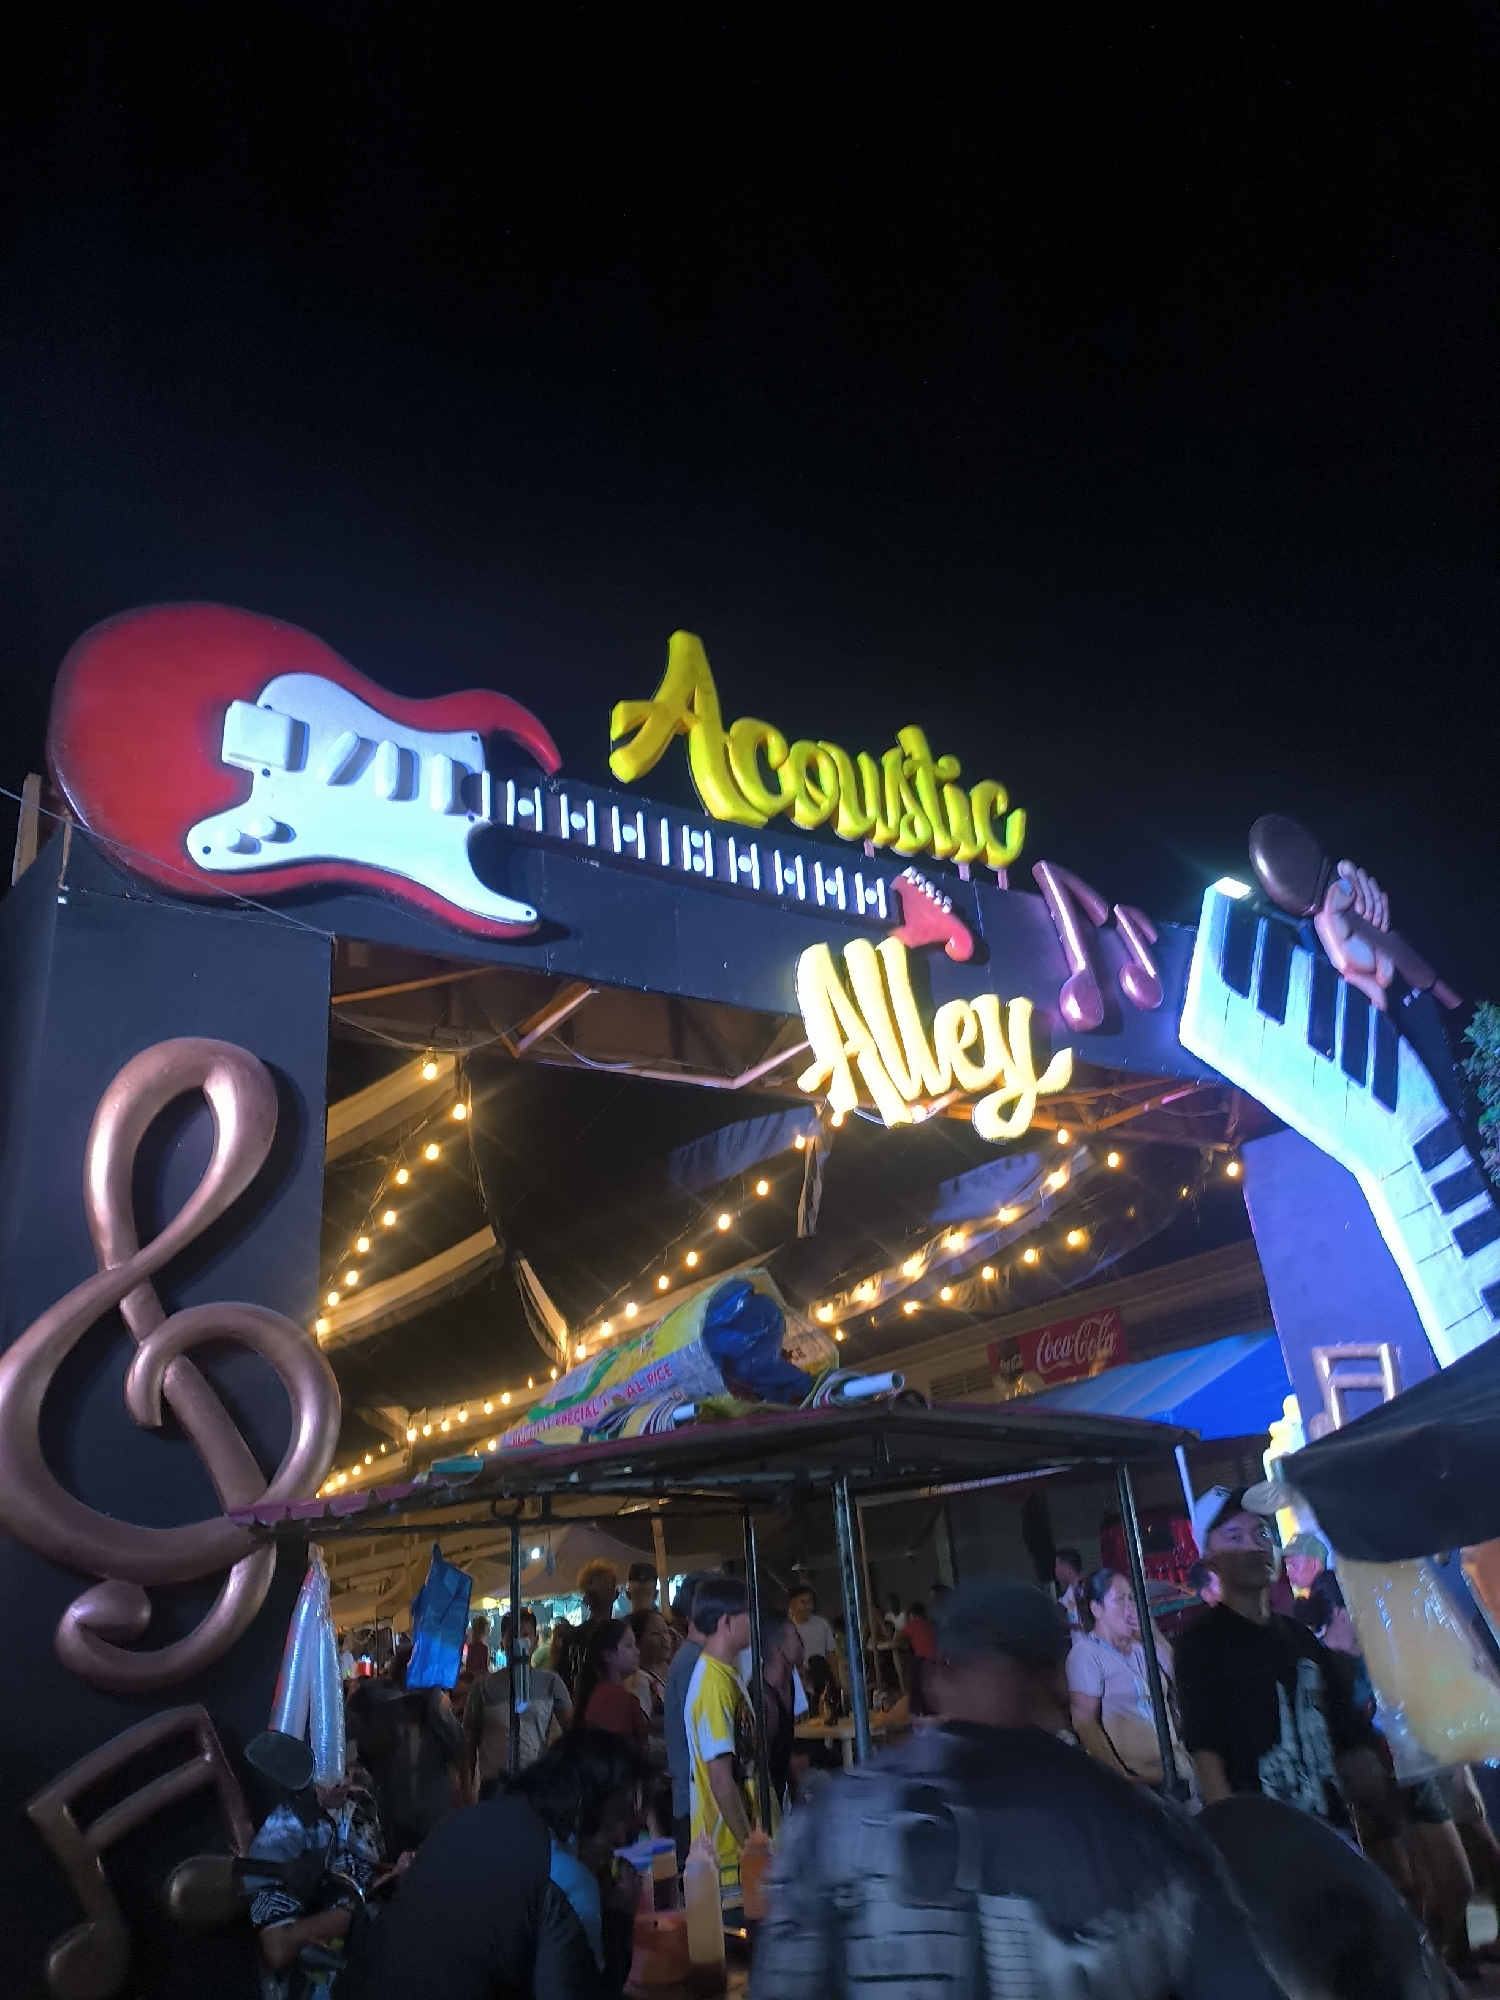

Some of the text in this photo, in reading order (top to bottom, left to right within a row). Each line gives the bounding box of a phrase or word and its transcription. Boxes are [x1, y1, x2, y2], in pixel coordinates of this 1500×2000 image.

[609, 630, 1026, 869] Acoustic
[797, 938, 1073, 1140] Alley
[555, 1401, 600, 1427] SPECIAL
[646, 1362, 673, 1387] RICE
